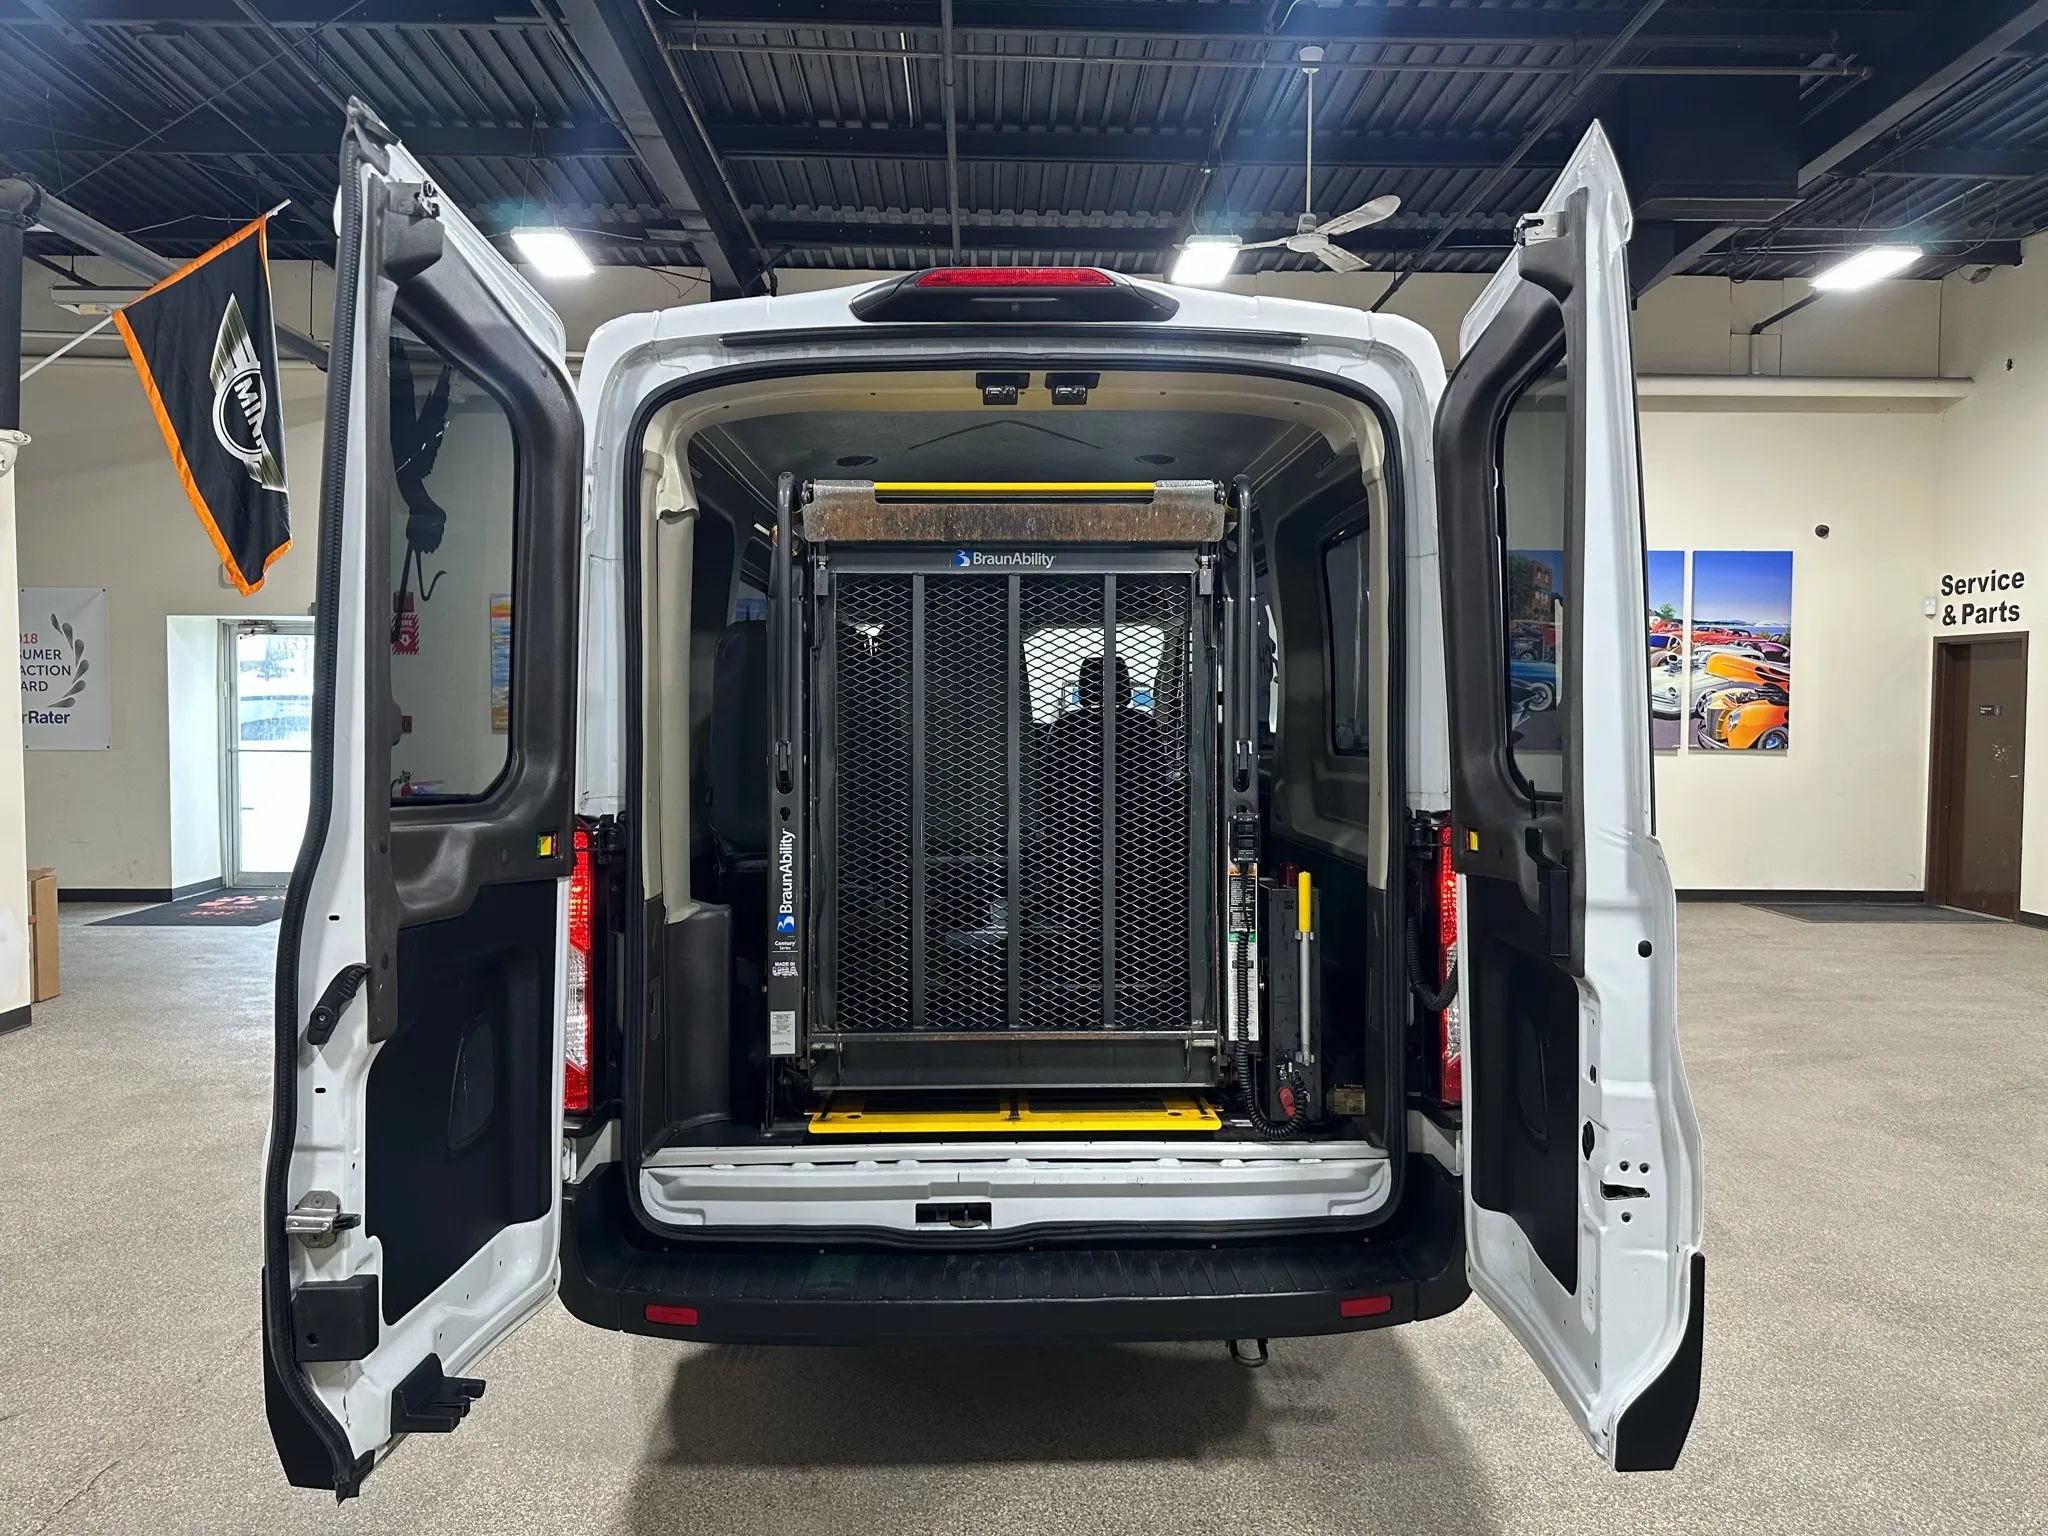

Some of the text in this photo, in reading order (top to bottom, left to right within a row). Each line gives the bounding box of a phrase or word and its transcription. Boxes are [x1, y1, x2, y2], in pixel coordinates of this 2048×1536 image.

[973, 551, 1055, 569] BraunAbility
[1941, 569, 2025, 597] Service
[1942, 600, 2020, 626] & Parts
[20, 632, 38, 644] 18
[20, 649, 62, 660] UMER
[779, 828, 796, 914] BraunAbility
